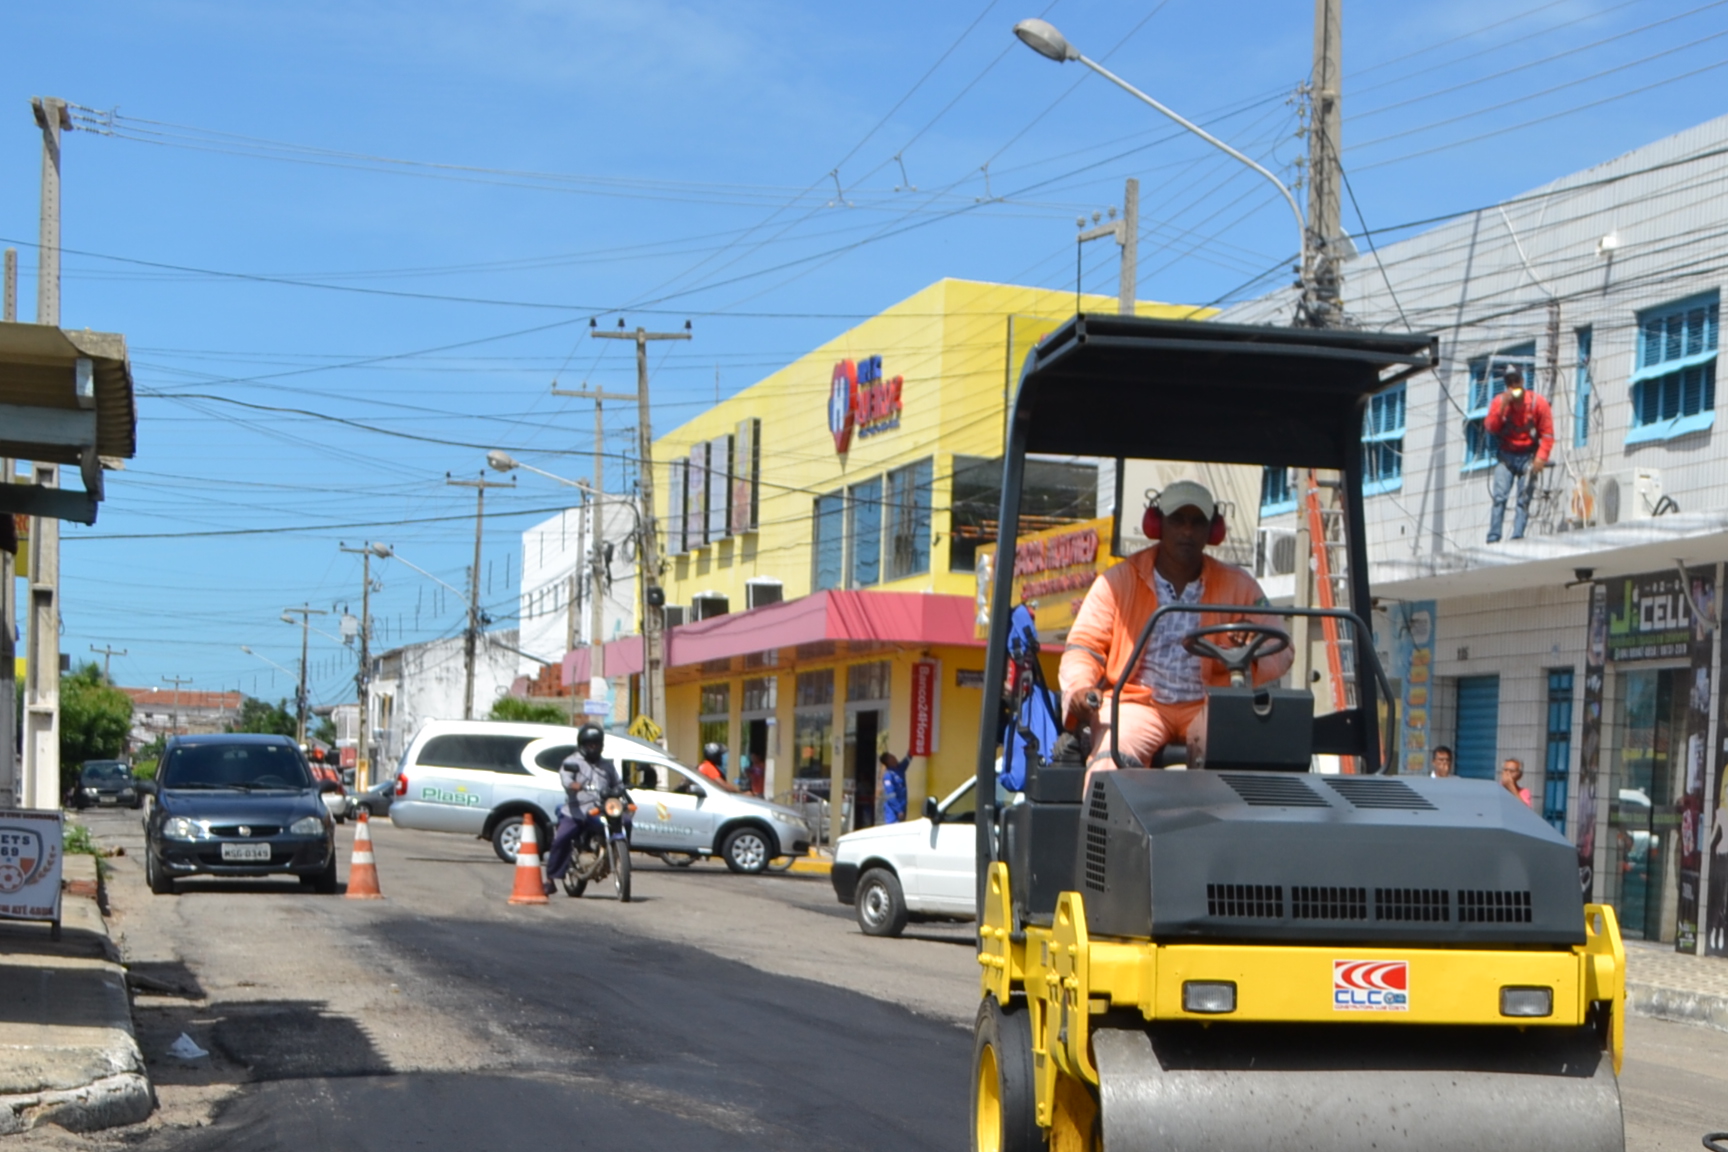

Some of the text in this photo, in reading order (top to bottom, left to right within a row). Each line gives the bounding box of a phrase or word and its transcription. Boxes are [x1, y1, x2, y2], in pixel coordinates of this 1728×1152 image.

[1640, 593, 1689, 631] CELL
[916, 666, 930, 754] Banco24Horas
[422, 788, 479, 806] Plasp
[1335, 990, 1382, 1004] CLC
